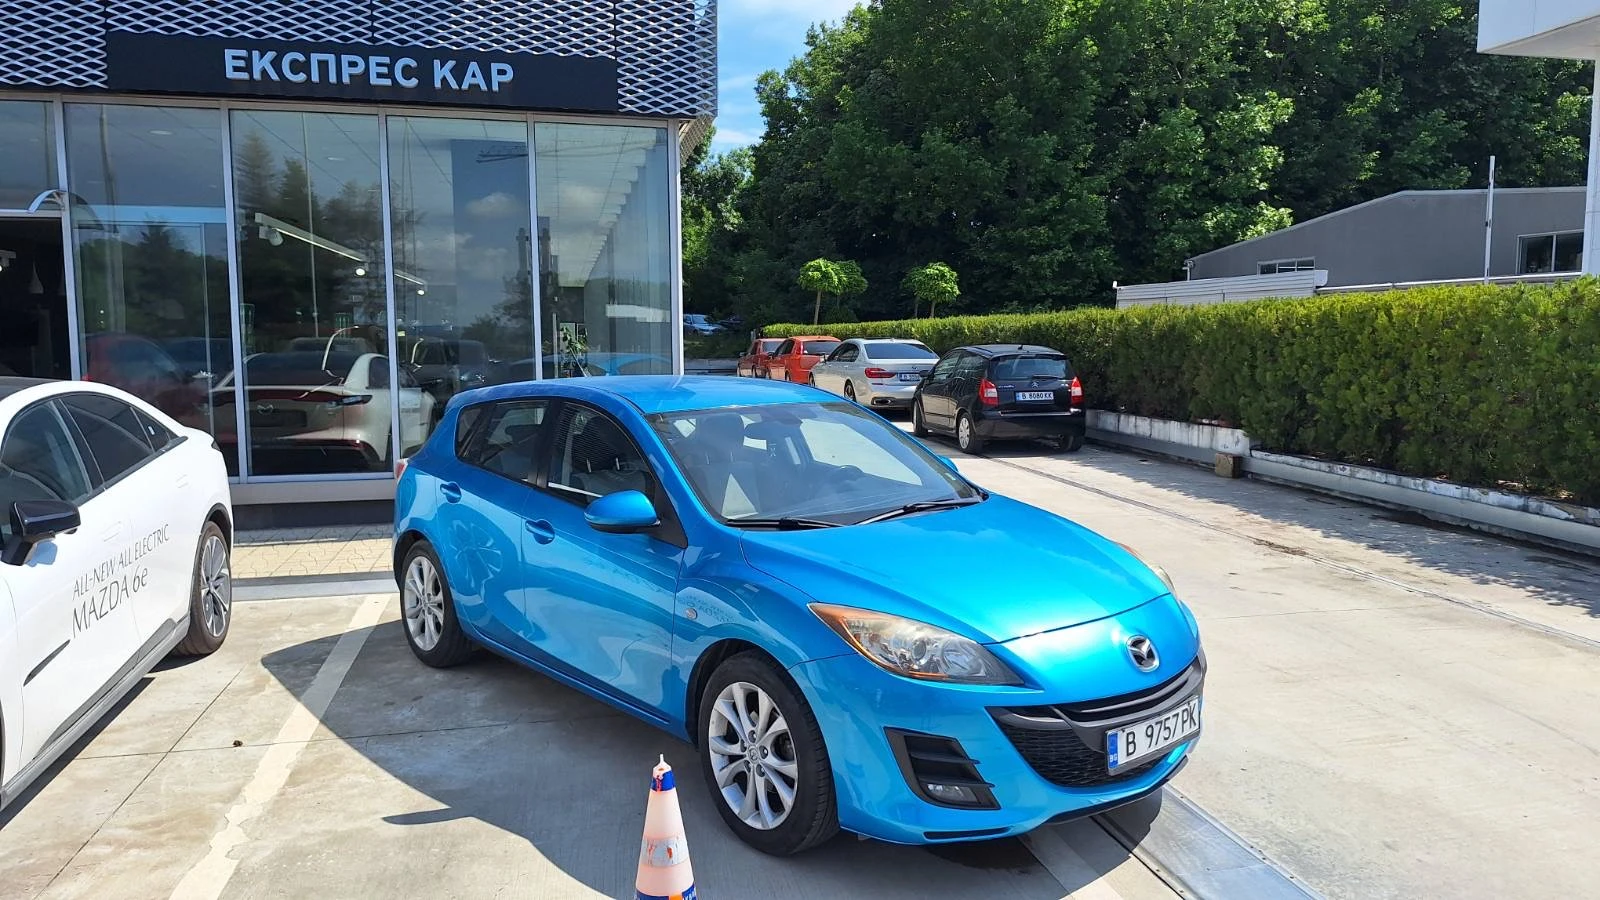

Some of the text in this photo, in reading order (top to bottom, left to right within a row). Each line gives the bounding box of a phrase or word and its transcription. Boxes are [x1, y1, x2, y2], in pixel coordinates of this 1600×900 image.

[224, 48, 514, 91] ЕКСПРЕС КАР
[73, 524, 169, 600] ALL-NEW ALL ELECTRIC
[73, 564, 148, 638] MAZDA 6e
